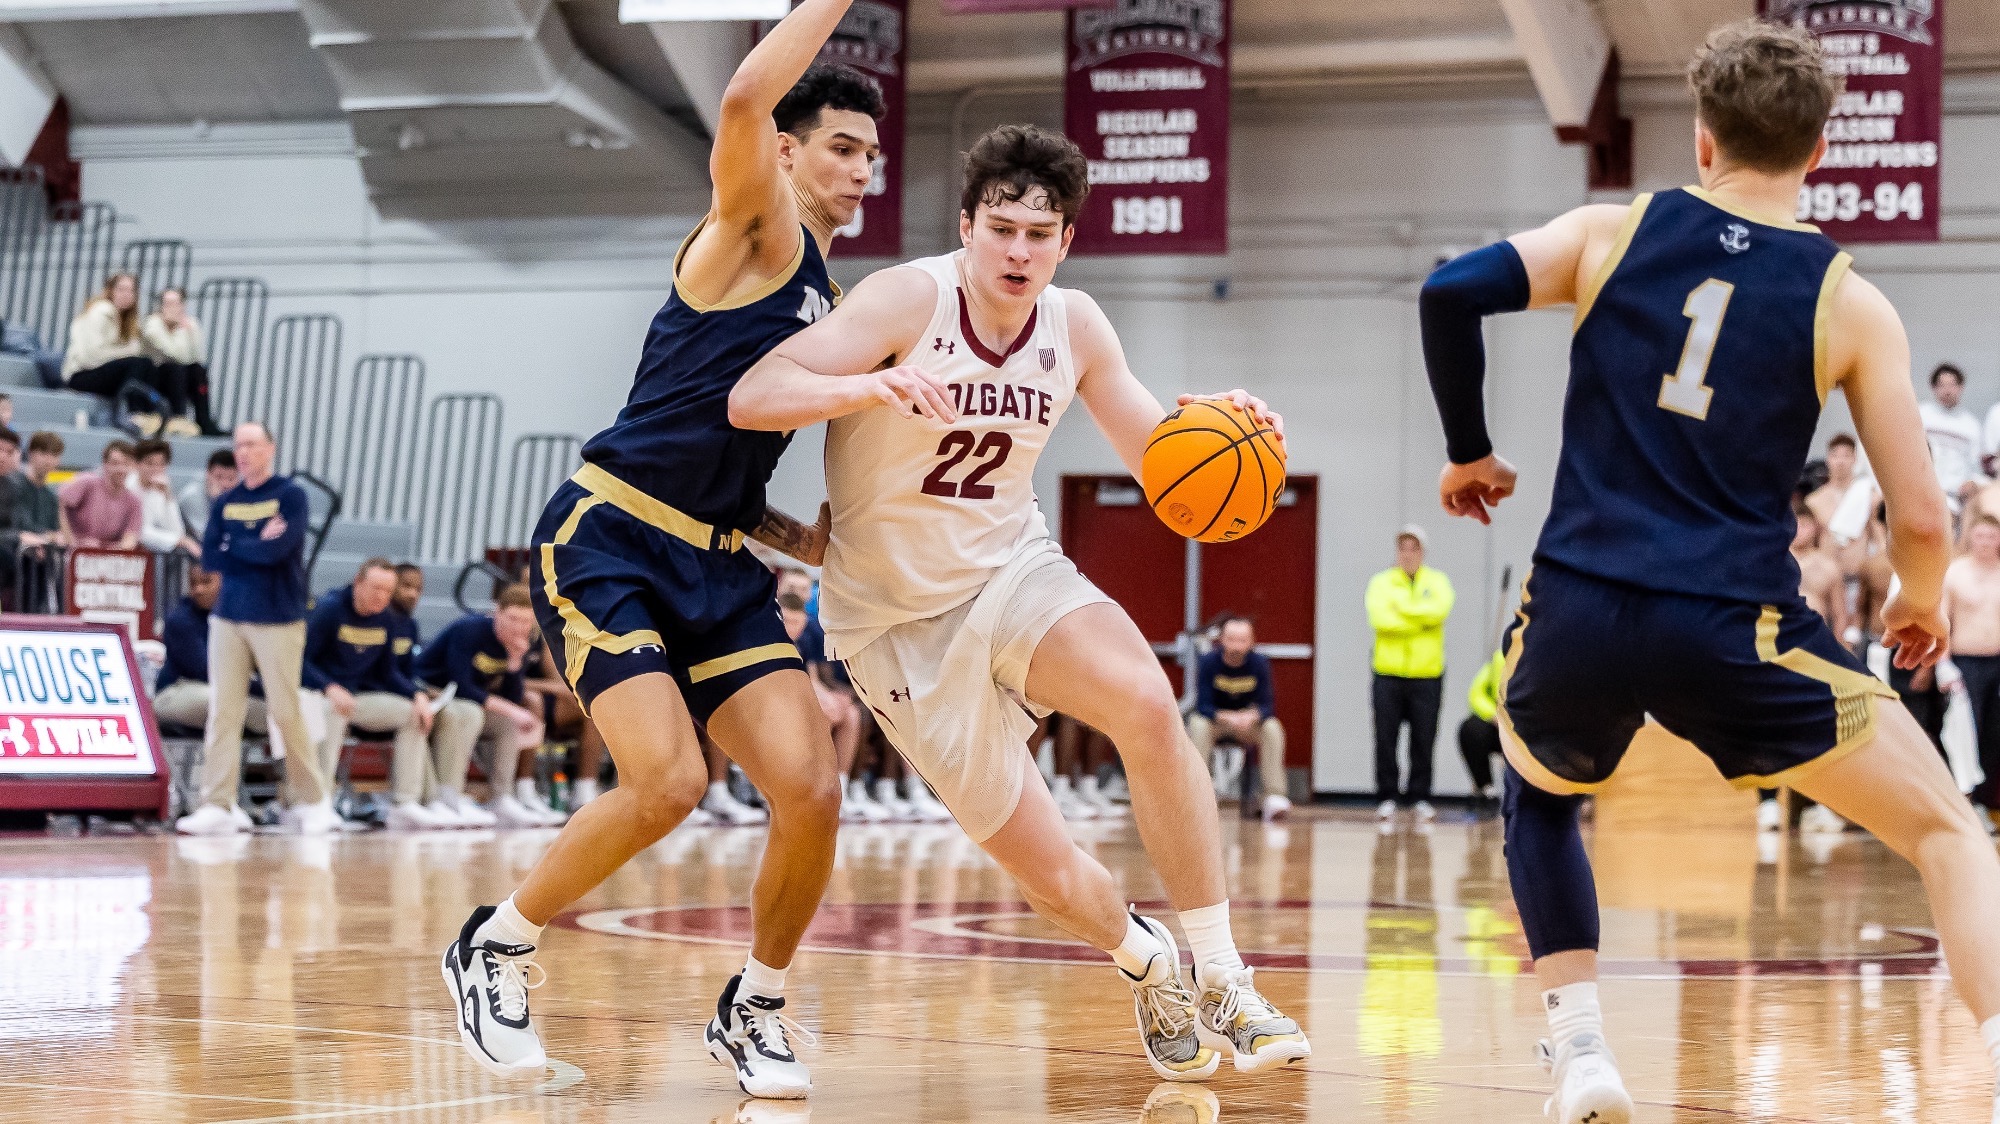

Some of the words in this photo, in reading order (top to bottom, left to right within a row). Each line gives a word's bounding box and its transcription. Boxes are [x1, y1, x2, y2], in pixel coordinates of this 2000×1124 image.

[1089, 68, 1207, 92] VOLLEYBALL
[1097, 110, 1198, 135] REGULAR
[1103, 134, 1190, 159] SEASON
[1087, 158, 1211, 184] CHAMPIONS
[1112, 196, 1183, 234] 1991
[1656, 277, 1736, 422] 1
[913, 382, 1053, 427] OLGATE
[920, 430, 1013, 500] 22
